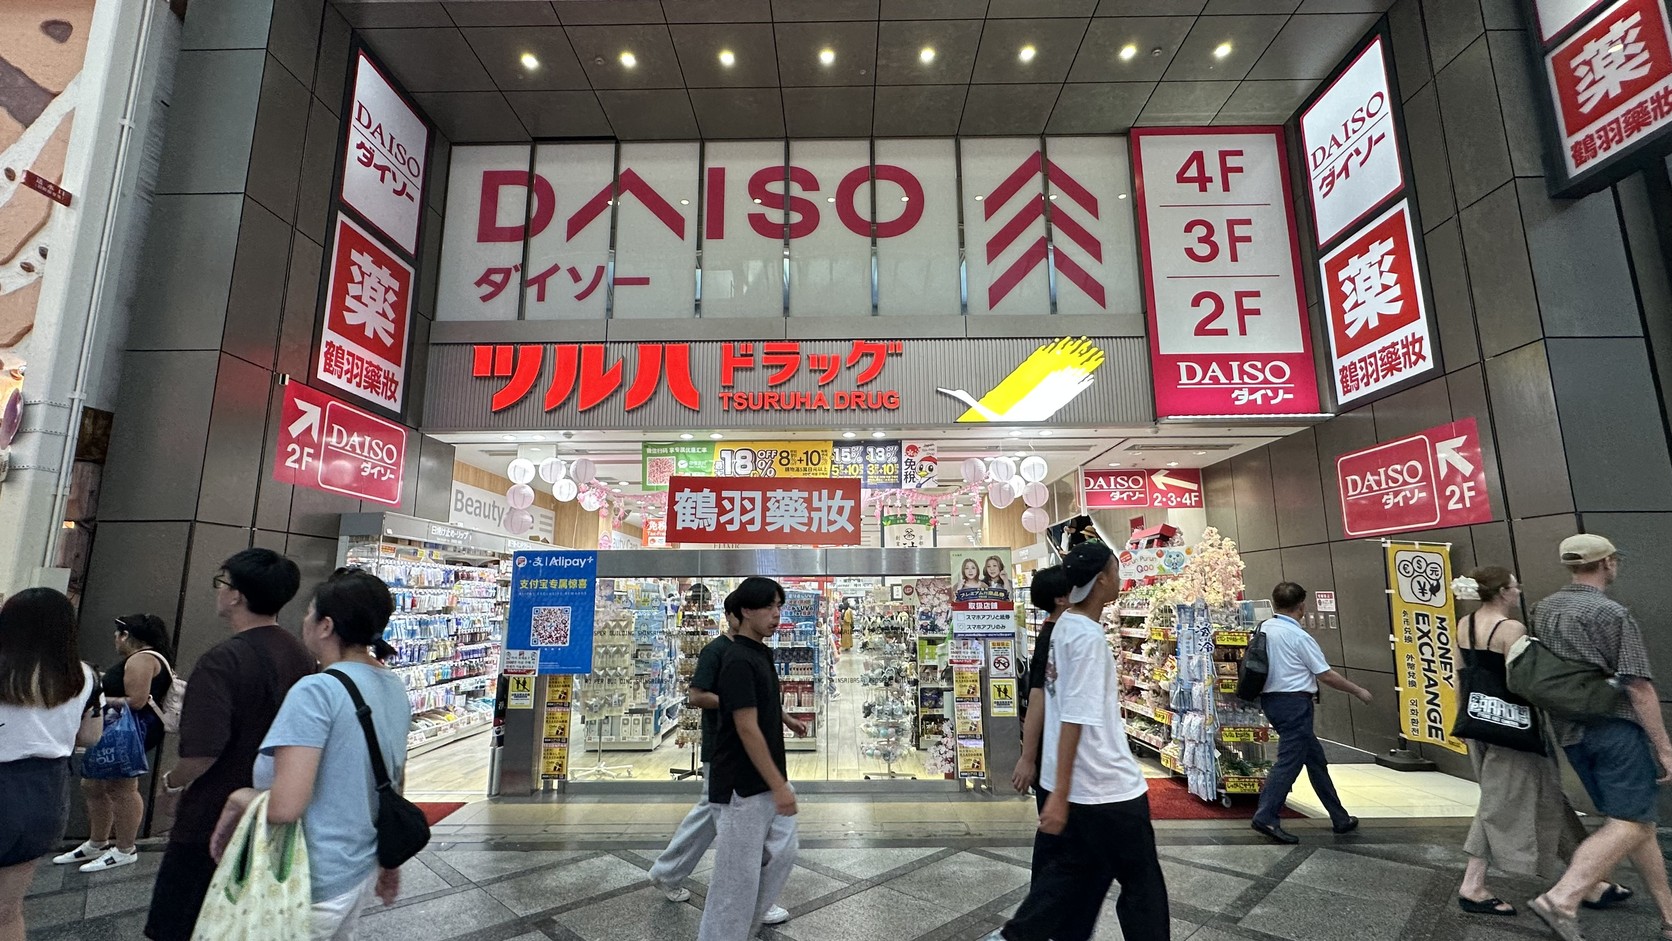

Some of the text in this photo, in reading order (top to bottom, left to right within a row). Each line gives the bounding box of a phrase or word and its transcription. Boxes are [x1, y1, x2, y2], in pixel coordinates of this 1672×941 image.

[1569, 11, 1653, 114] 薬
[355, 99, 420, 179] DAISO
[1310, 91, 1385, 172] DAISO
[355, 140, 415, 203] ダイソー
[1175, 149, 1244, 193] 4F
[1319, 131, 1386, 199] ダイソー
[476, 164, 926, 243] DAISO
[1183, 218, 1253, 263] 3F
[342, 248, 400, 348] 薬
[474, 262, 650, 303] ダイソー
[1337, 236, 1404, 339] 薬
[1190, 289, 1262, 336] 2F
[322, 339, 399, 404] 鶴羽藥妝
[472, 343, 700, 412] ツルハ
[720, 339, 904, 387] ドラッグ
[1177, 360, 1291, 384] DAISO
[1338, 331, 1428, 397] 鶴羽藥妝
[718, 390, 901, 411] TSURUHA DRUG
[1231, 388, 1294, 405] ダイソー
[285, 443, 315, 471] 2F
[329, 423, 398, 465] DAISO
[757, 450, 778, 460] OFF
[778, 450, 791, 467] 8
[360, 461, 395, 481] ダイソー
[904, 458, 916, 483] 免税
[1085, 476, 1144, 489] DAISO
[1345, 460, 1423, 496] DAISO
[453, 488, 505, 527] Beauty
[674, 487, 855, 533] 鶴羽藥妝
[1110, 491, 1145, 501] ダイソー
[1381, 488, 1427, 510] ダイソー
[1445, 481, 1476, 510] 2F
[549, 556, 593, 568] Alipay+
[520, 579, 587, 589] 支付宝专属惊喜
[1436, 615, 1454, 688] MONEY
[1415, 612, 1445, 742] EXCHANGE
